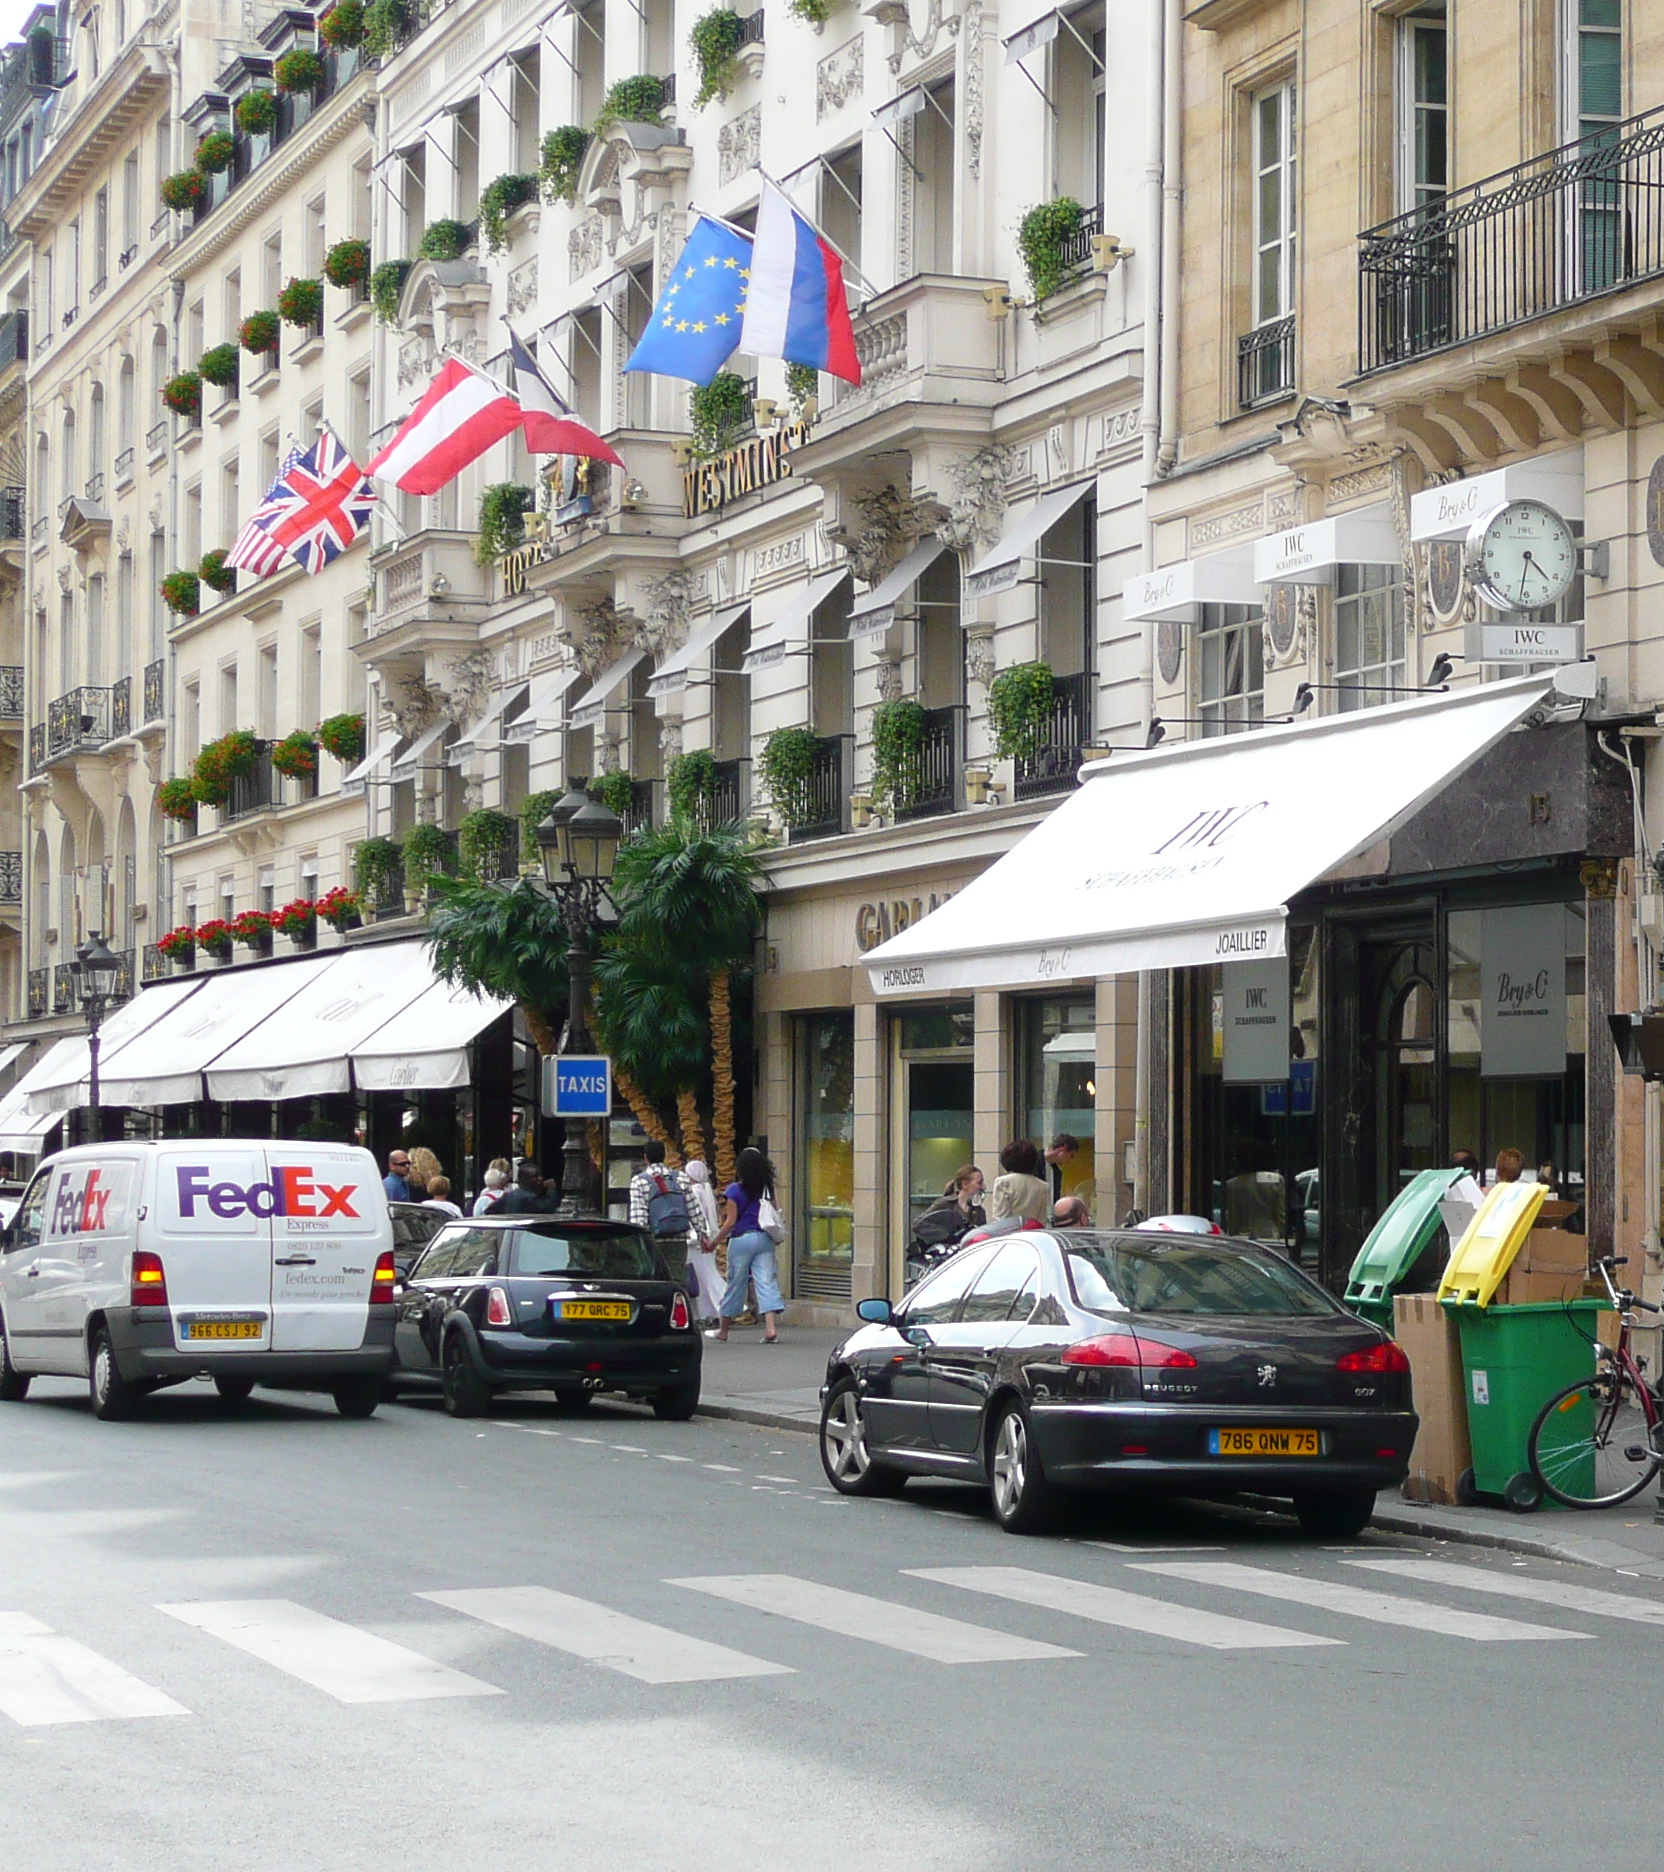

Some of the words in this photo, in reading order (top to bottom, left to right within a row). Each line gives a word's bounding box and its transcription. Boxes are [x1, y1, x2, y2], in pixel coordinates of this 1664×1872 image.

[683, 421, 813, 519] WESTMINST
[1505, 517, 1512, 525] 11
[1521, 512, 1529, 520] 12
[1492, 531, 1501, 539] 10
[1284, 532, 1305, 557] IWC
[1514, 629, 1545, 645] IWC
[1499, 647, 1560, 656] SCHAFFHAUSEN
[1149, 800, 1269, 856] IWC
[1215, 929, 1268, 954] JOAILLIER
[883, 967, 925, 987] HORLOGER
[1246, 987, 1268, 1009] IWC
[558, 1076, 606, 1093] TAXIS
[176, 1166, 361, 1219] FedEx
[51, 1168, 111, 1236] FedEx
[287, 1218, 329, 1232] Express
[286, 1273, 345, 1286] fedex.com
[564, 1303, 586, 1316] 177
[588, 1304, 612, 1317] QRC
[613, 1305, 628, 1317] 75
[189, 1323, 212, 1338] 966
[216, 1323, 239, 1338] CSJ
[244, 1323, 260, 1337] 92
[1144, 1384, 1198, 1393] PEUGEOT
[1354, 1387, 1376, 1397] 607
[1222, 1432, 1253, 1450] 786
[1259, 1432, 1290, 1451] QNW
[1295, 1433, 1315, 1451] 75
